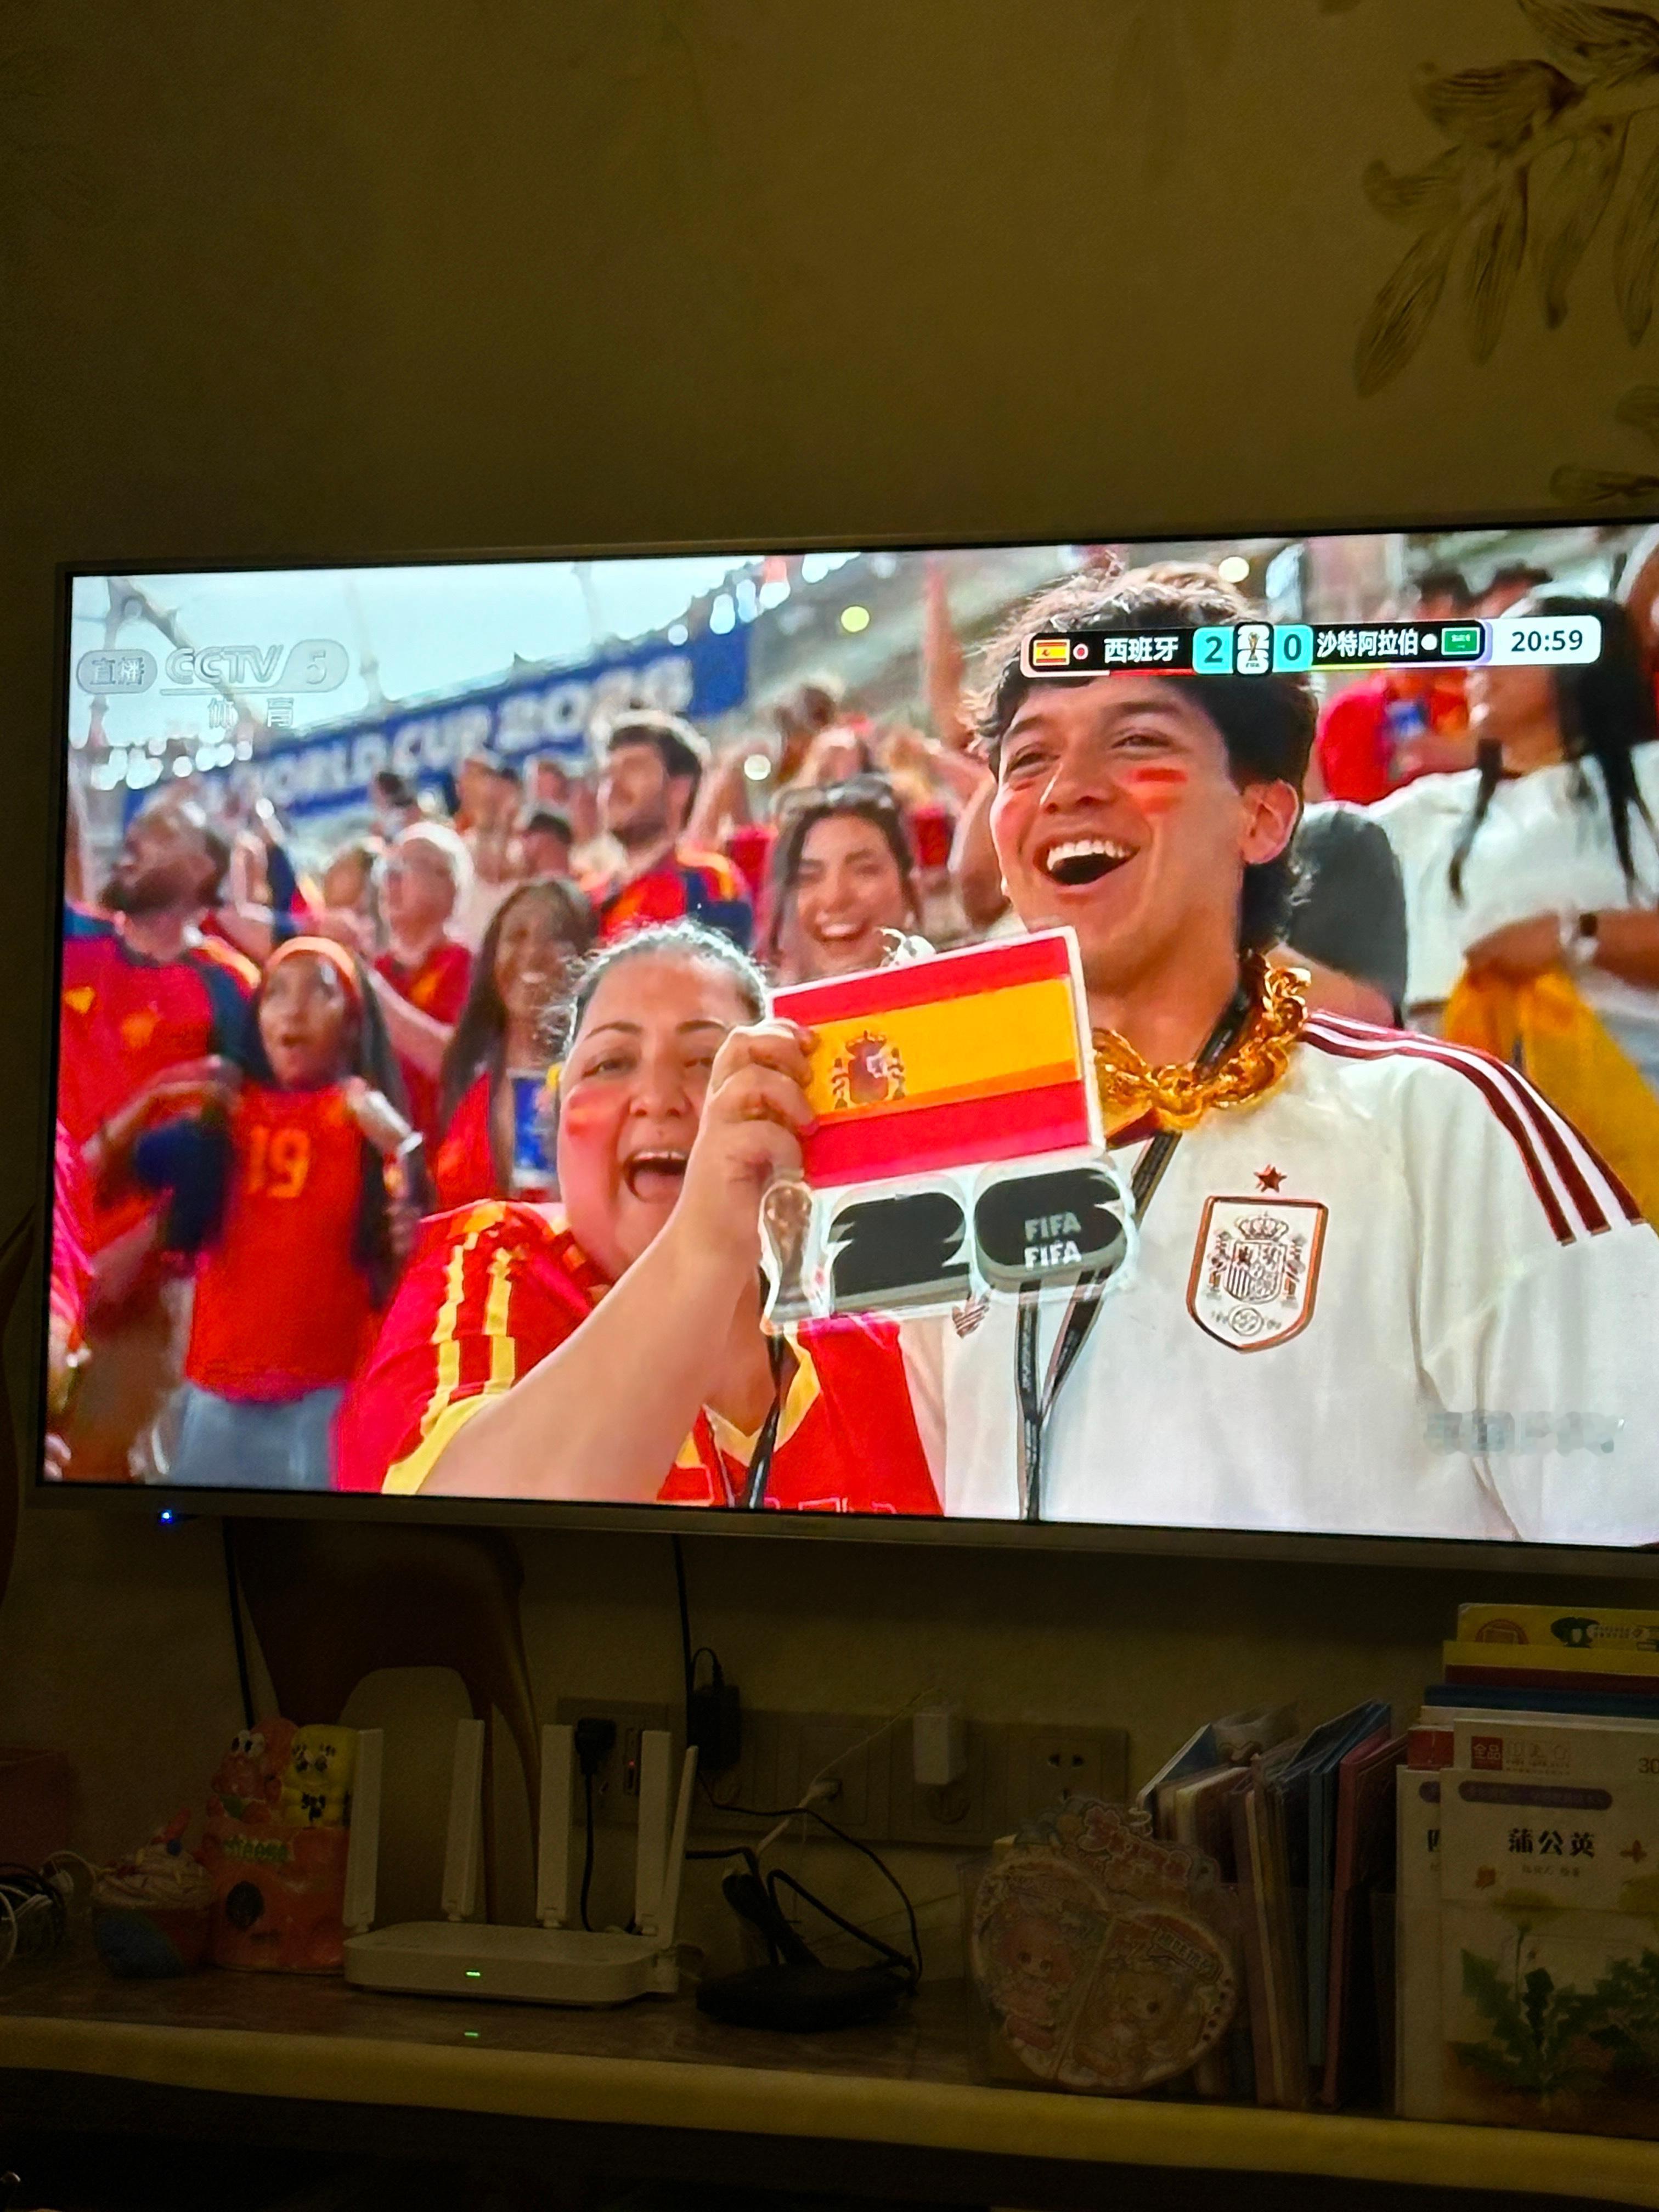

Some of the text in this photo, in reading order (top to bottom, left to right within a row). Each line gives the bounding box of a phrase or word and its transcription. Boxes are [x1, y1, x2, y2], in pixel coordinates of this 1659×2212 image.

[1104, 636, 1179, 663] 西班牙
[1204, 635, 1223, 663] 2
[1284, 634, 1302, 661] 0
[1317, 628, 1419, 658] 沙特阿拉伯
[1511, 629, 1583, 652] 20:59
[89, 657, 145, 686] 直播
[249, 1126, 311, 1198] 19
[1024, 1211, 1082, 1242] FIFA
[1024, 1240, 1082, 1271] FIFA
[1509, 1828, 1595, 1858] 蒲公英
